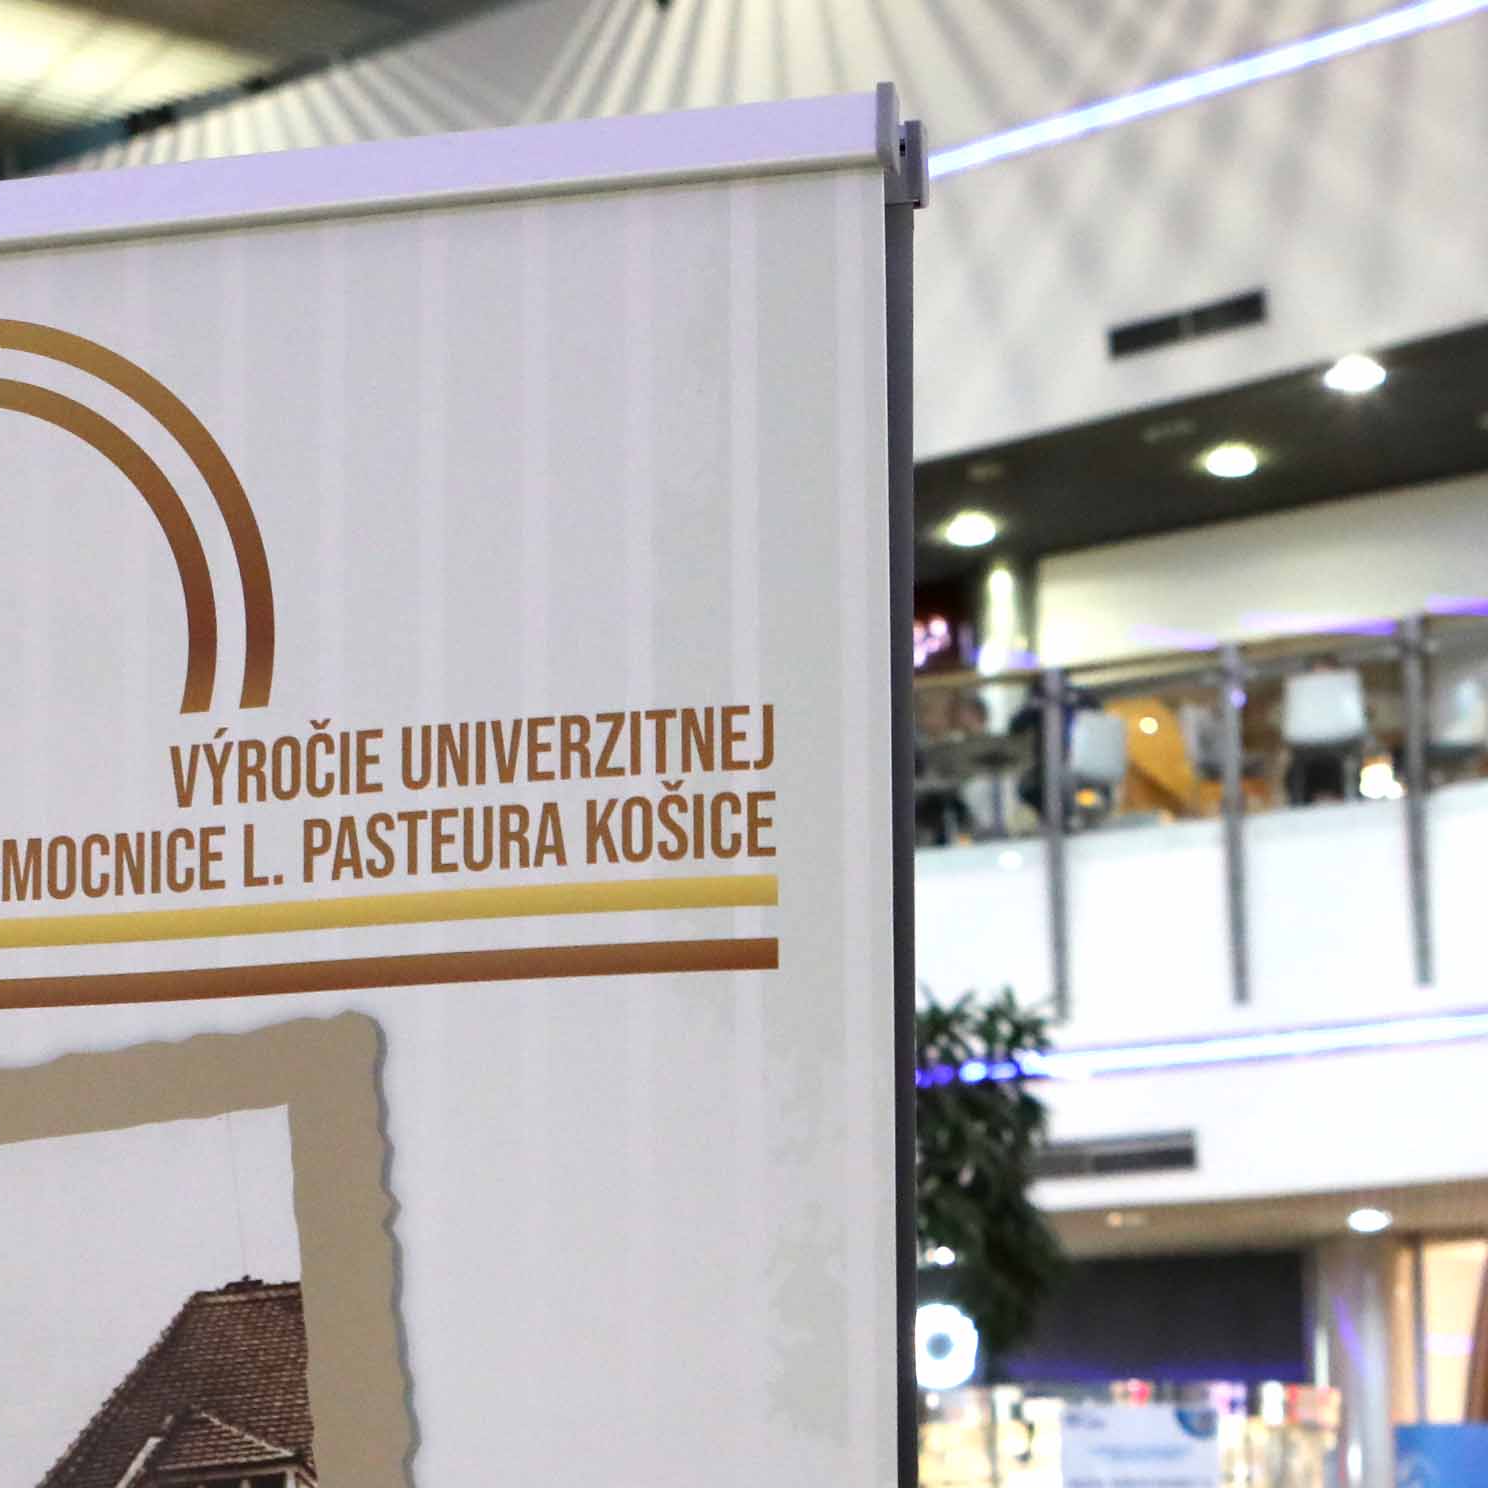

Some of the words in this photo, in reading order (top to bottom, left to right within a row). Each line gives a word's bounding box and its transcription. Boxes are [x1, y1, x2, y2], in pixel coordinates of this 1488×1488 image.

[169, 719, 384, 808] VÝROČIE
[400, 704, 776, 793] UNIVERZITNEJ
[242, 822, 284, 889] L.
[302, 800, 568, 884] PASTEURA
[585, 780, 778, 865] KOŠICE
